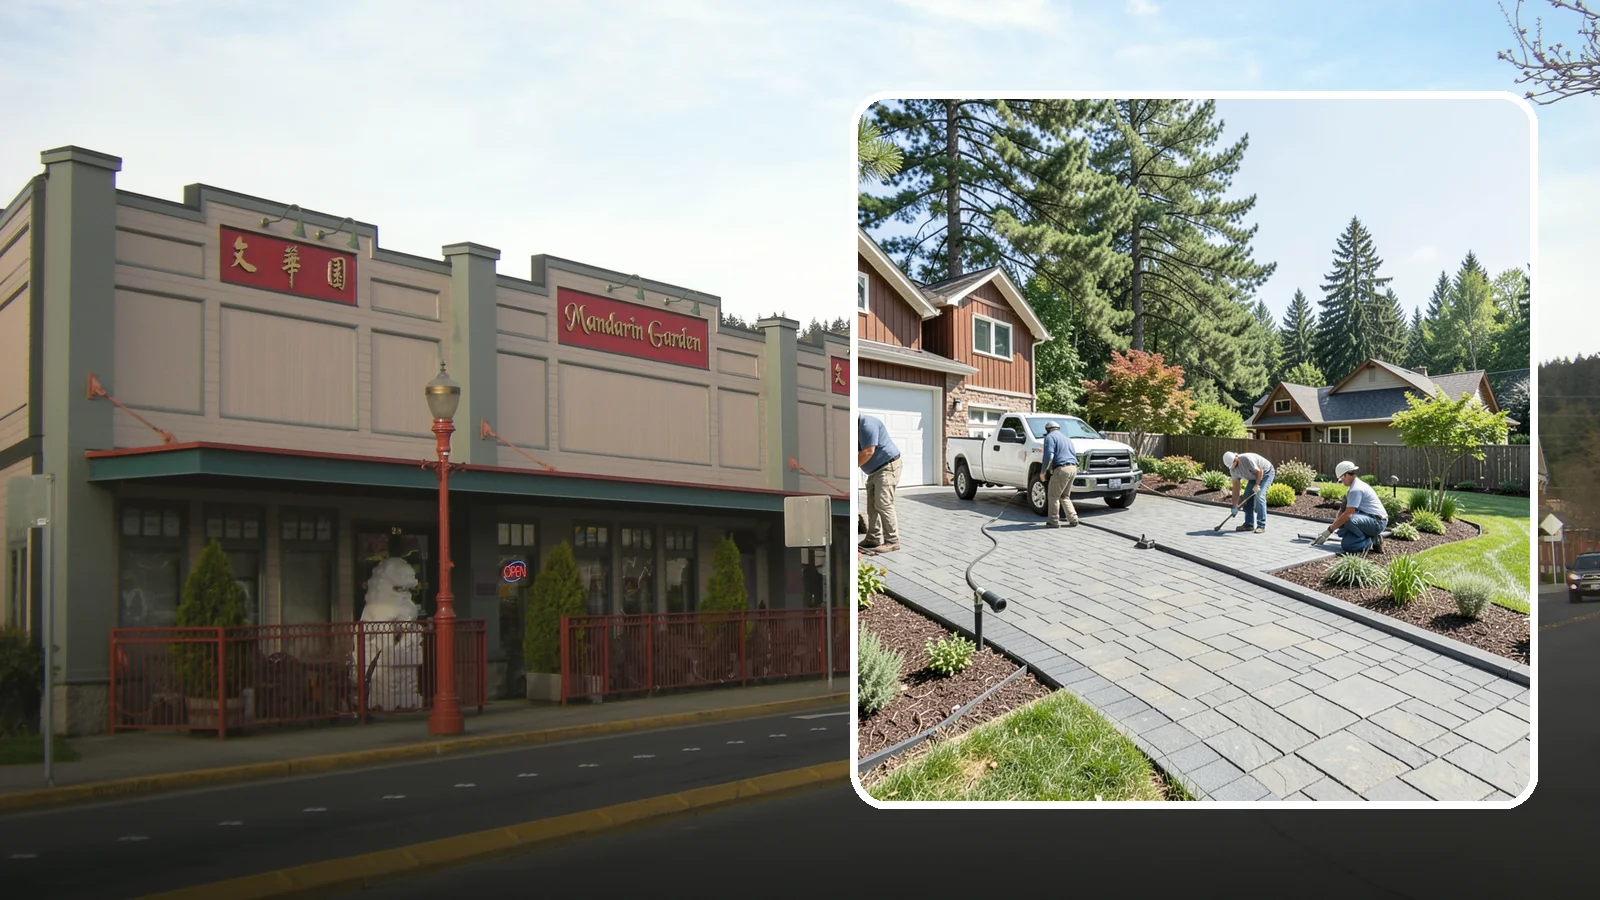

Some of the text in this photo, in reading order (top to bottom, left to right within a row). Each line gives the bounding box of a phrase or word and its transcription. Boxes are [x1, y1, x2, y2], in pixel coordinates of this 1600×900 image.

[565, 302, 702, 352] Mandarin Garden
[503, 565, 526, 578] OPEN
